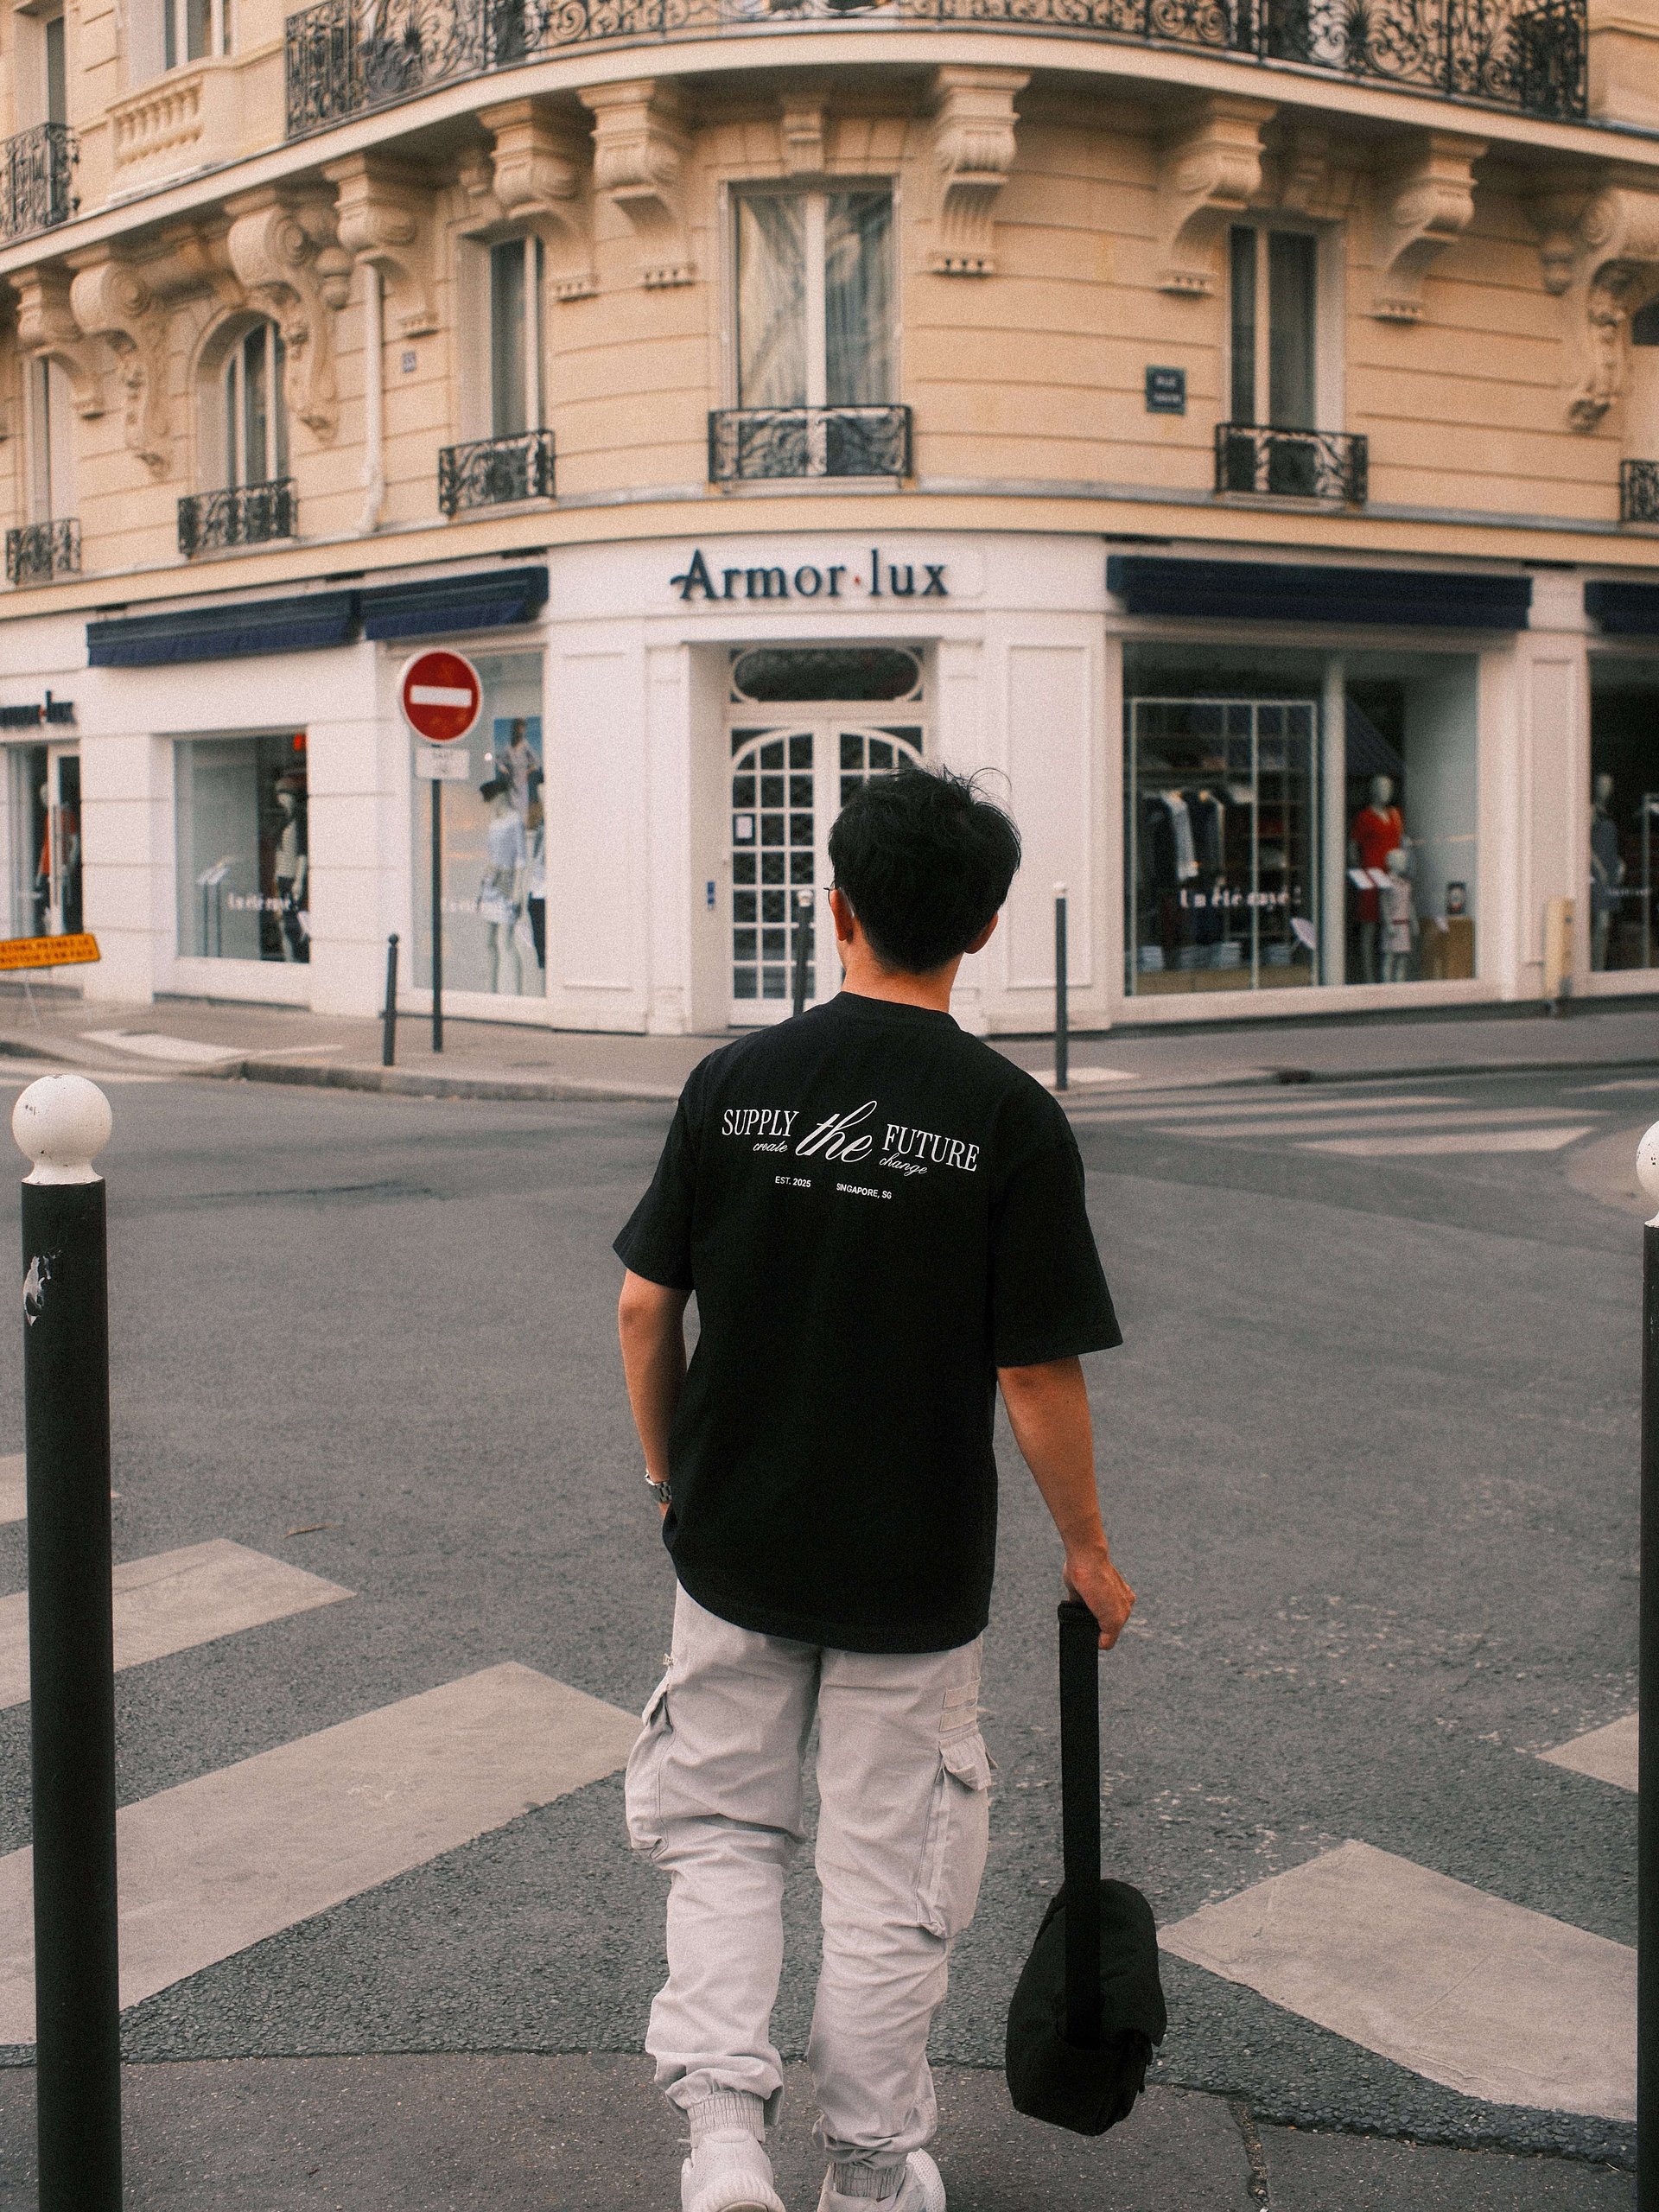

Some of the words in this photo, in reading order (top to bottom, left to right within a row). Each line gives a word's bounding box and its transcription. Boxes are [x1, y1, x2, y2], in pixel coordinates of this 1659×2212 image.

[721, 1109, 799, 1137] SUPPLY
[795, 1100, 878, 1163] the
[881, 1123, 980, 1172] FUTURE
[753, 1140, 788, 1153] create
[879, 1152, 928, 1177] change
[774, 1175, 791, 1185] EST.
[792, 1178, 812, 1188] 2025
[836, 1183, 880, 1198] SINGAPORE,
[881, 1189, 893, 1199] SG
